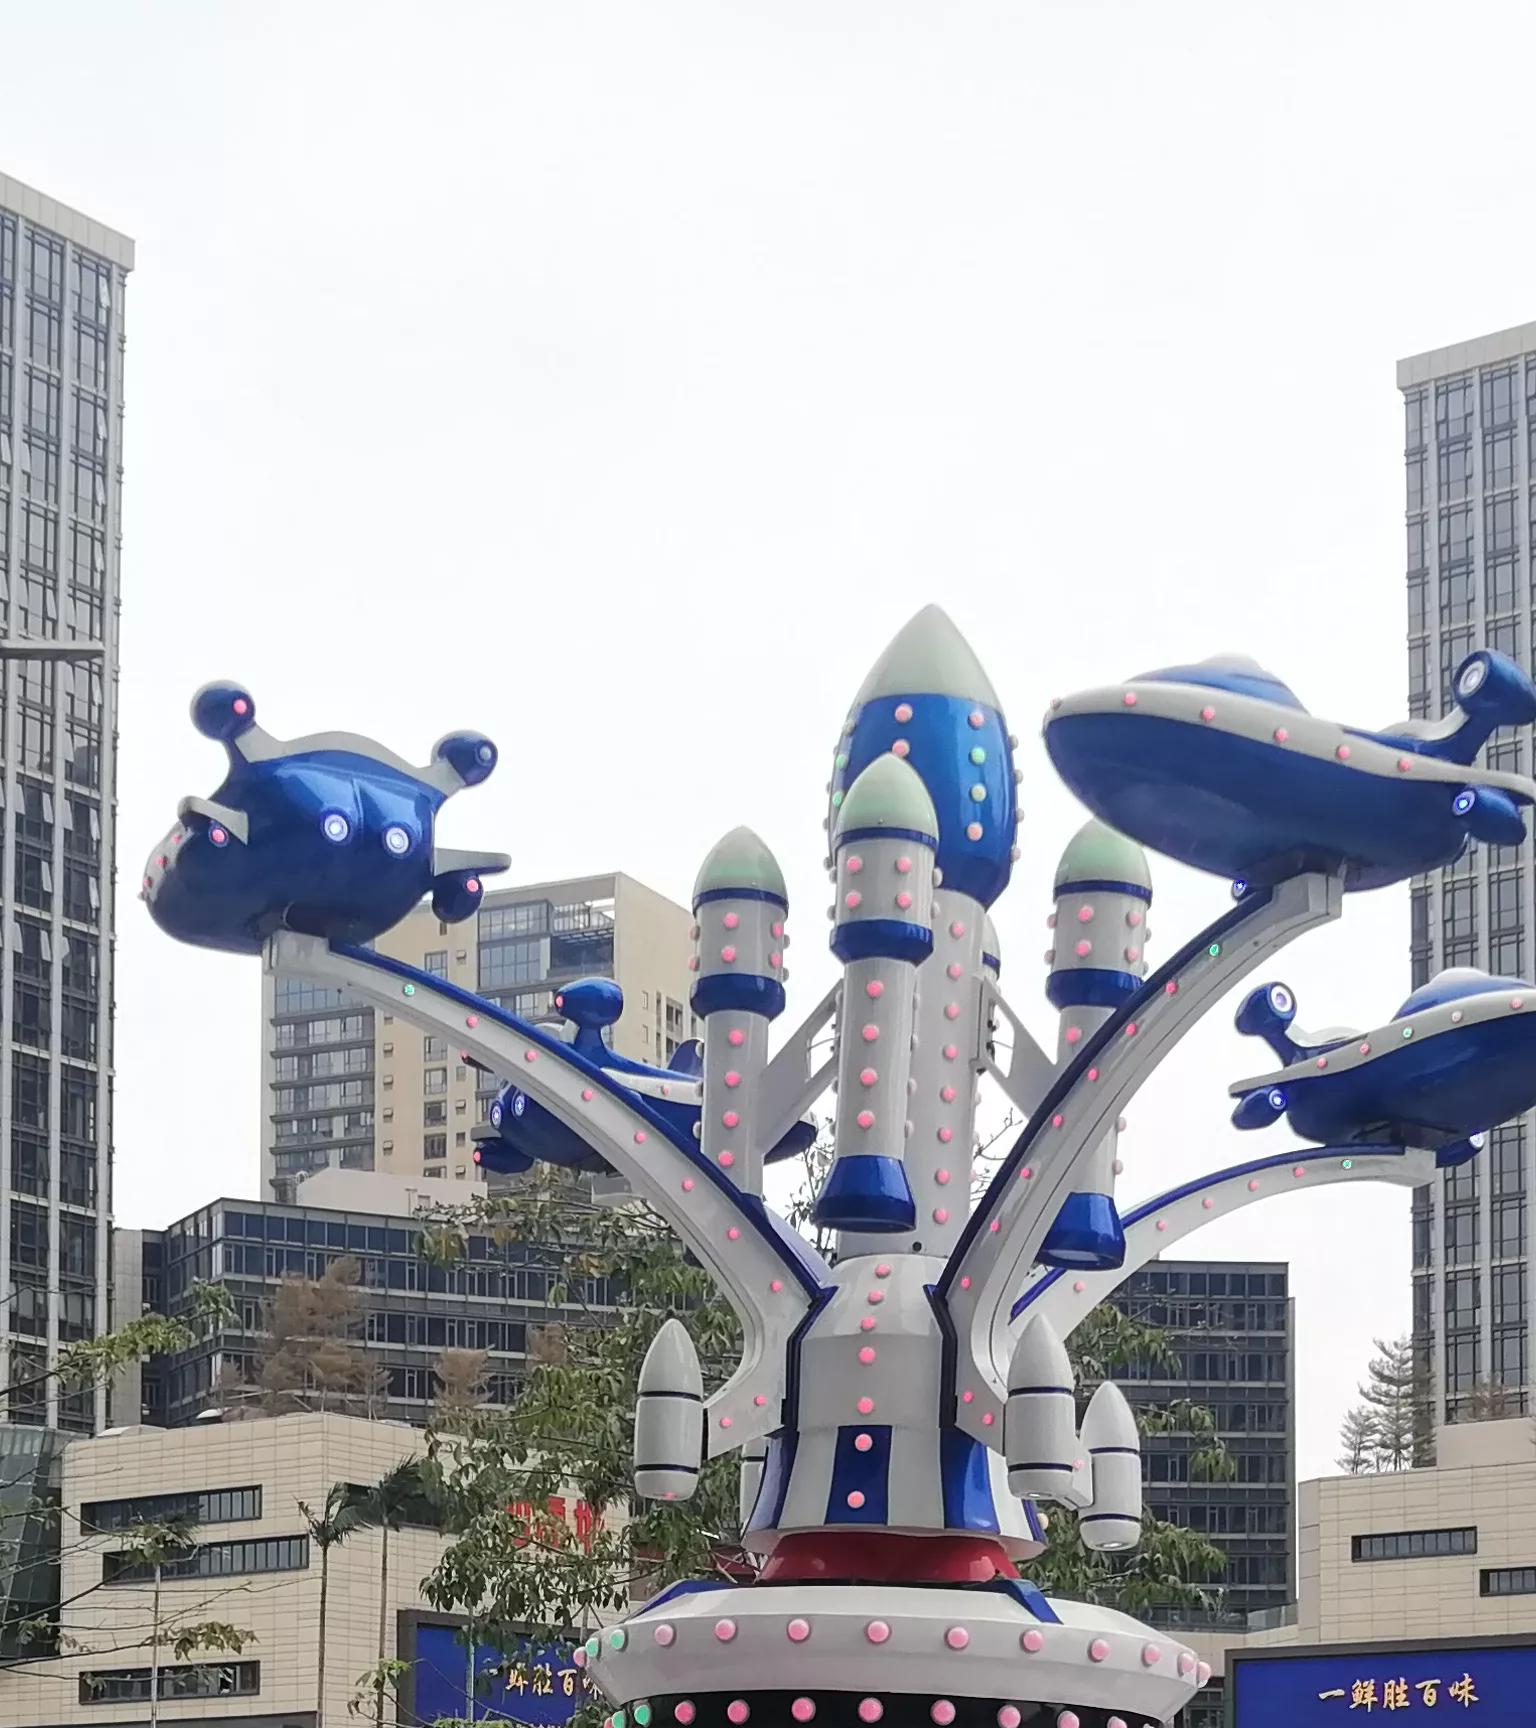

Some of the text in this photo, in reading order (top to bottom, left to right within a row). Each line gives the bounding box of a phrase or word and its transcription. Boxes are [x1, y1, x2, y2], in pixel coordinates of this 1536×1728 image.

[1318, 1672, 1480, 1712] 一鲜胜百味
